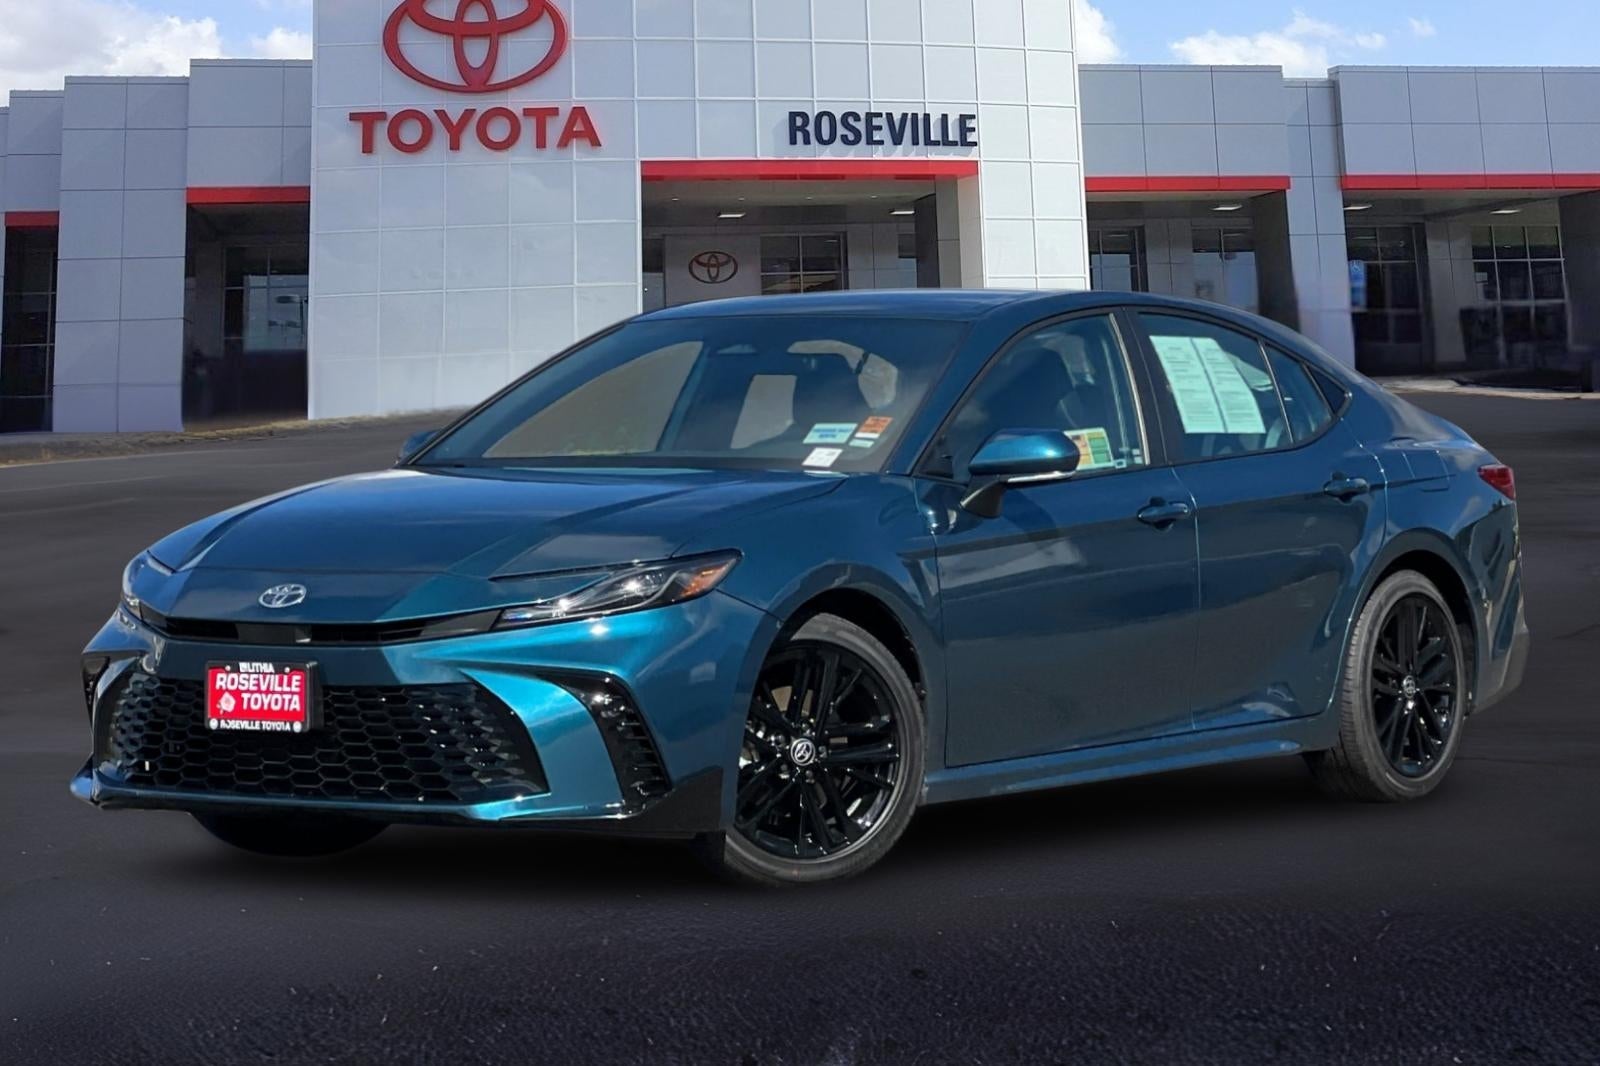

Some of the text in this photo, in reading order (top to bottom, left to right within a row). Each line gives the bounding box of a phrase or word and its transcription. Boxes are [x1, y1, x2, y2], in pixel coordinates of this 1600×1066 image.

[349, 106, 602, 154] TOYOTA
[788, 111, 978, 147] ROSEVILLE
[216, 673, 301, 691] ROSEVILLE
[241, 693, 300, 711] TOYOTA
[220, 719, 291, 731] ROSEVILLE TOYOTA
